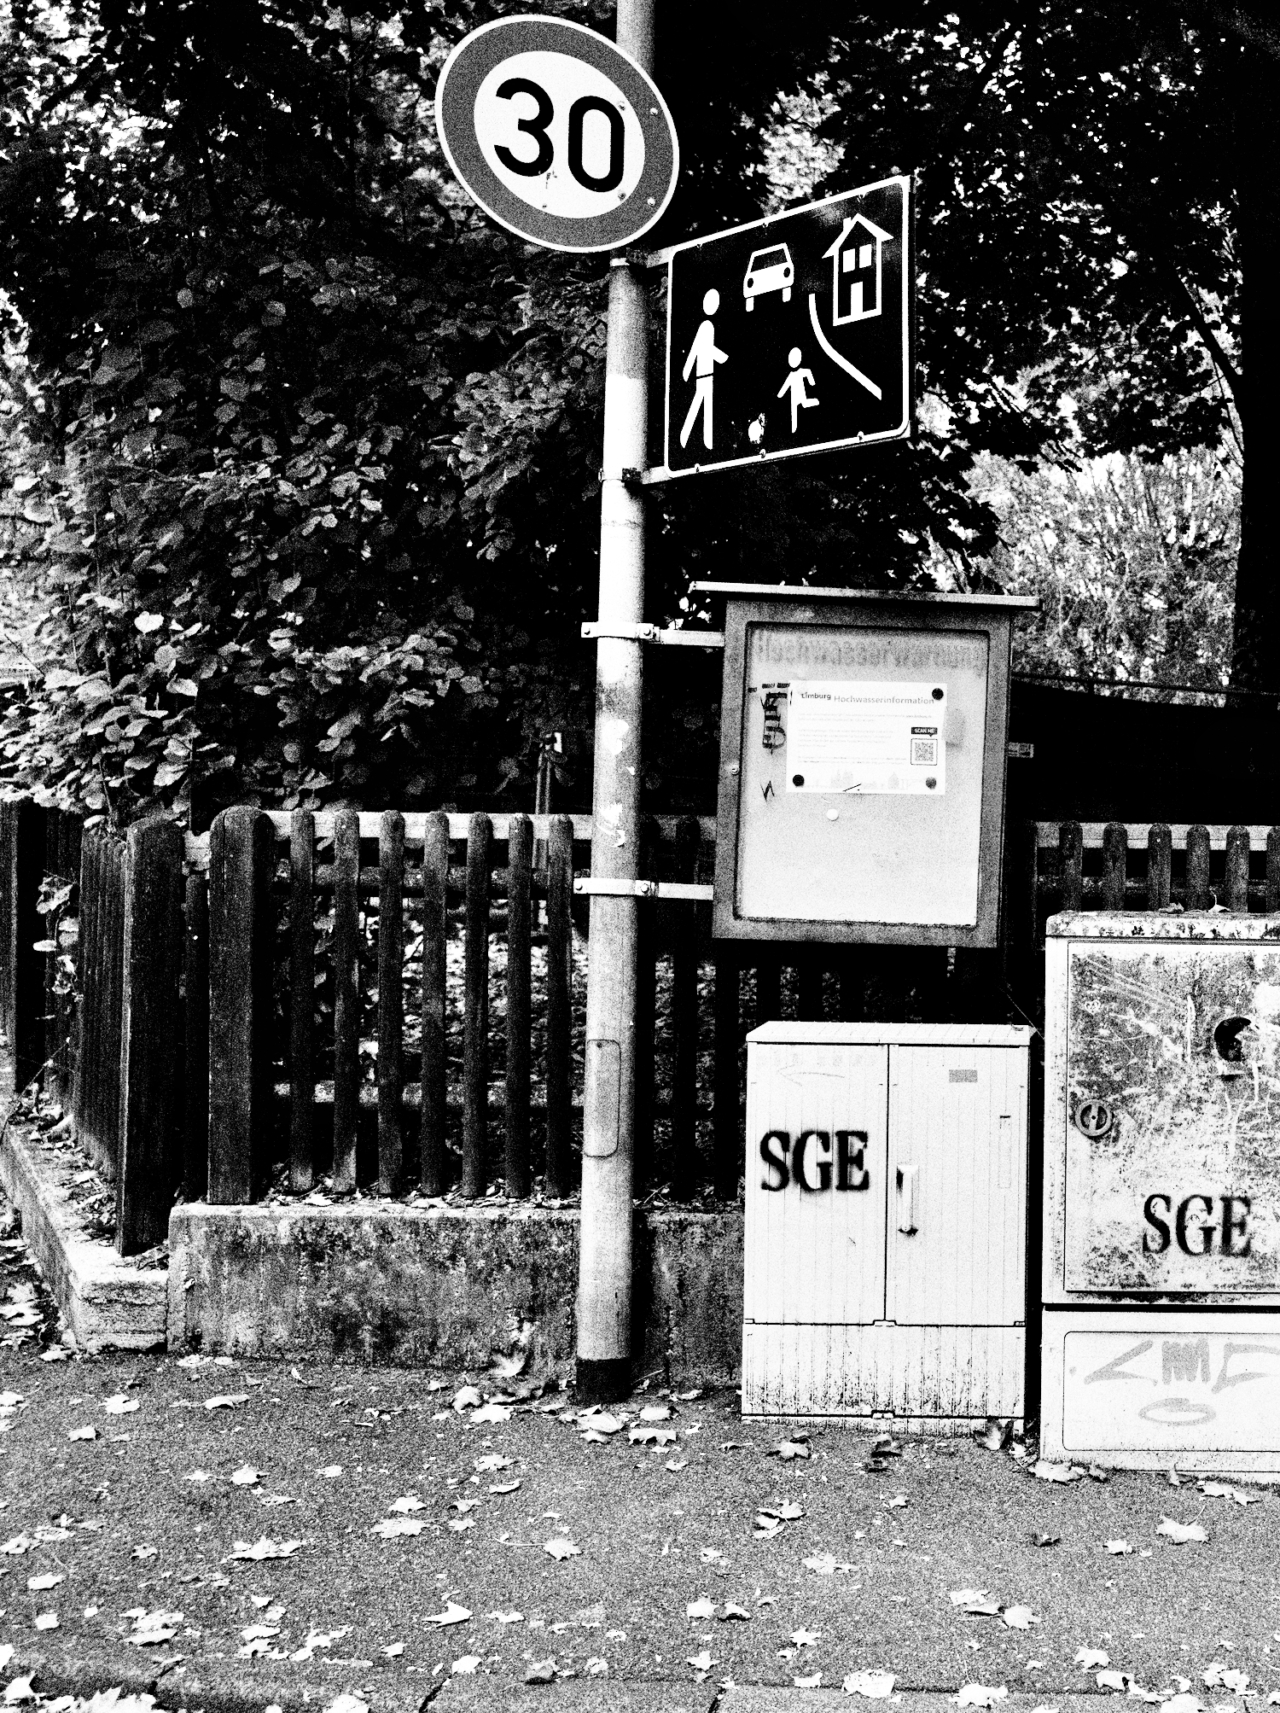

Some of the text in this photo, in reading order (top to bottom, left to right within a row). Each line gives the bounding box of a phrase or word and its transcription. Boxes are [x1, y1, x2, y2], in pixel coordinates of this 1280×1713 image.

[494, 77, 625, 193] 30
[833, 694, 935, 705] Hochwasserinformation
[760, 1129, 869, 1192] SGE
[1143, 1194, 1251, 1256] SGE
